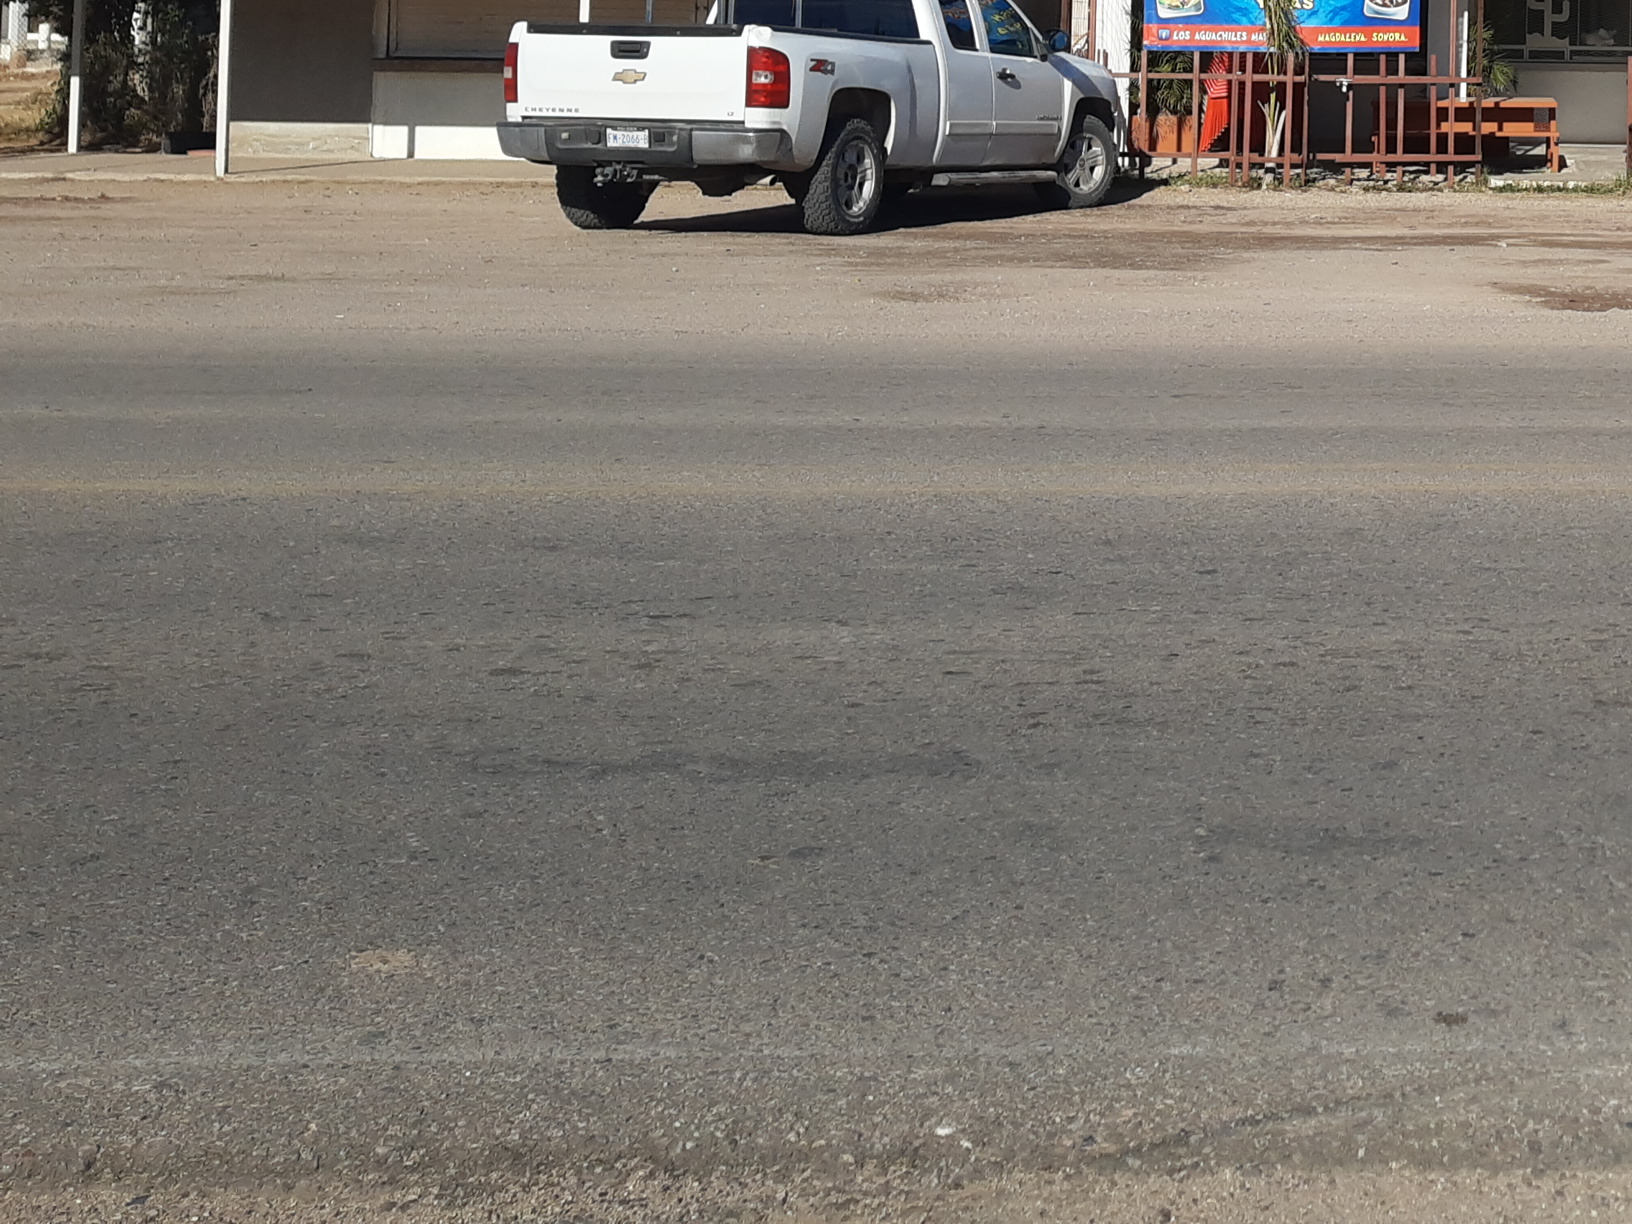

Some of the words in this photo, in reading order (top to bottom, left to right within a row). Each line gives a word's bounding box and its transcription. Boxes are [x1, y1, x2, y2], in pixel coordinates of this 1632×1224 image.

[1173, 30, 1191, 40] LOS
[1194, 30, 1247, 41] AGUACHILES
[524, 106, 581, 114] CHEYENNE
